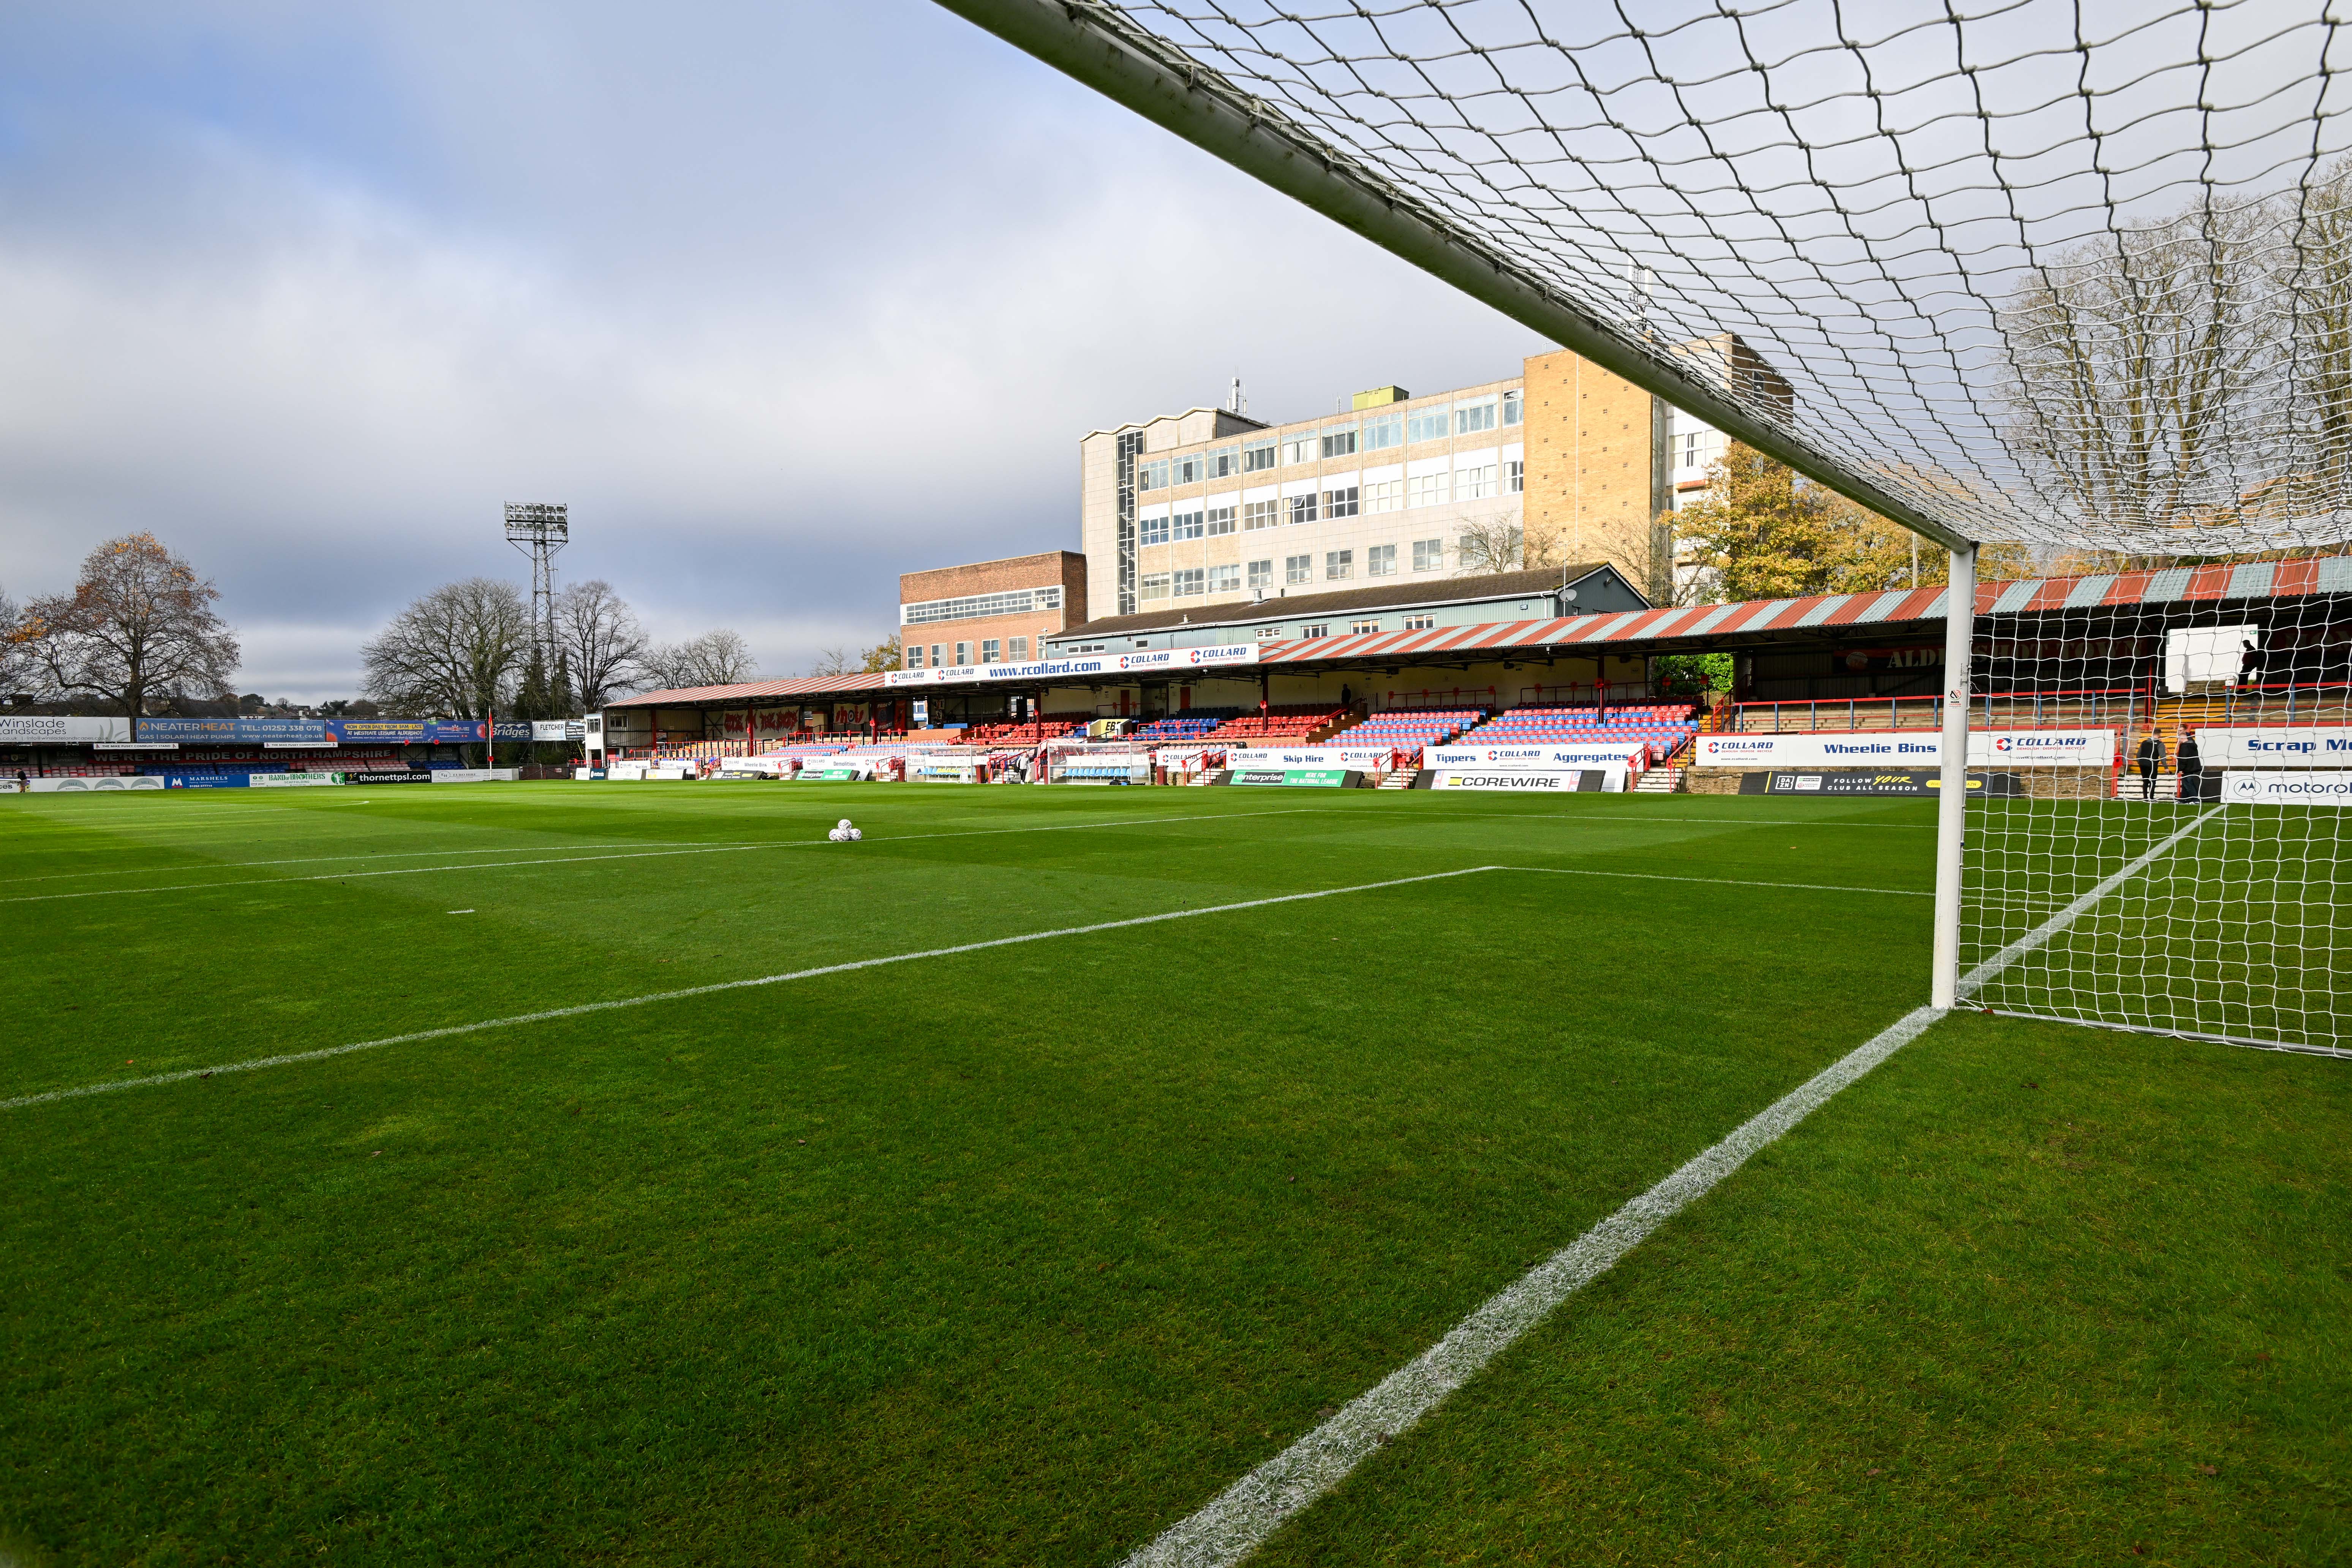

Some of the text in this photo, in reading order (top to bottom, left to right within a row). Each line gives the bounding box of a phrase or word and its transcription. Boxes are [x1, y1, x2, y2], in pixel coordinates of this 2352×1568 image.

[1131, 653, 1169, 663] COLLARD
[1203, 648, 1246, 658] COLLARD
[1887, 638, 2143, 669] ALDSHOT TOWN
[989, 661, 1100, 677] www.rcollard.com
[0, 718, 65, 728] Winslade
[1105, 722, 1121, 730] EB
[493, 727, 530, 737] Bridges
[1824, 743, 1936, 753] Wheelie Bins
[2248, 739, 2352, 753] Scrap M
[94, 753, 144, 762] WE'RE
[185, 752, 230, 760] PRIDE
[313, 749, 391, 759] HAMPSHIRE
[1435, 754, 1476, 763] Tippers
[1553, 753, 1628, 763] Aggregates
[359, 773, 430, 782] thornettpsl.com
[1462, 778, 1560, 787] COREWIRE
[1873, 776, 1913, 786] YOUR
